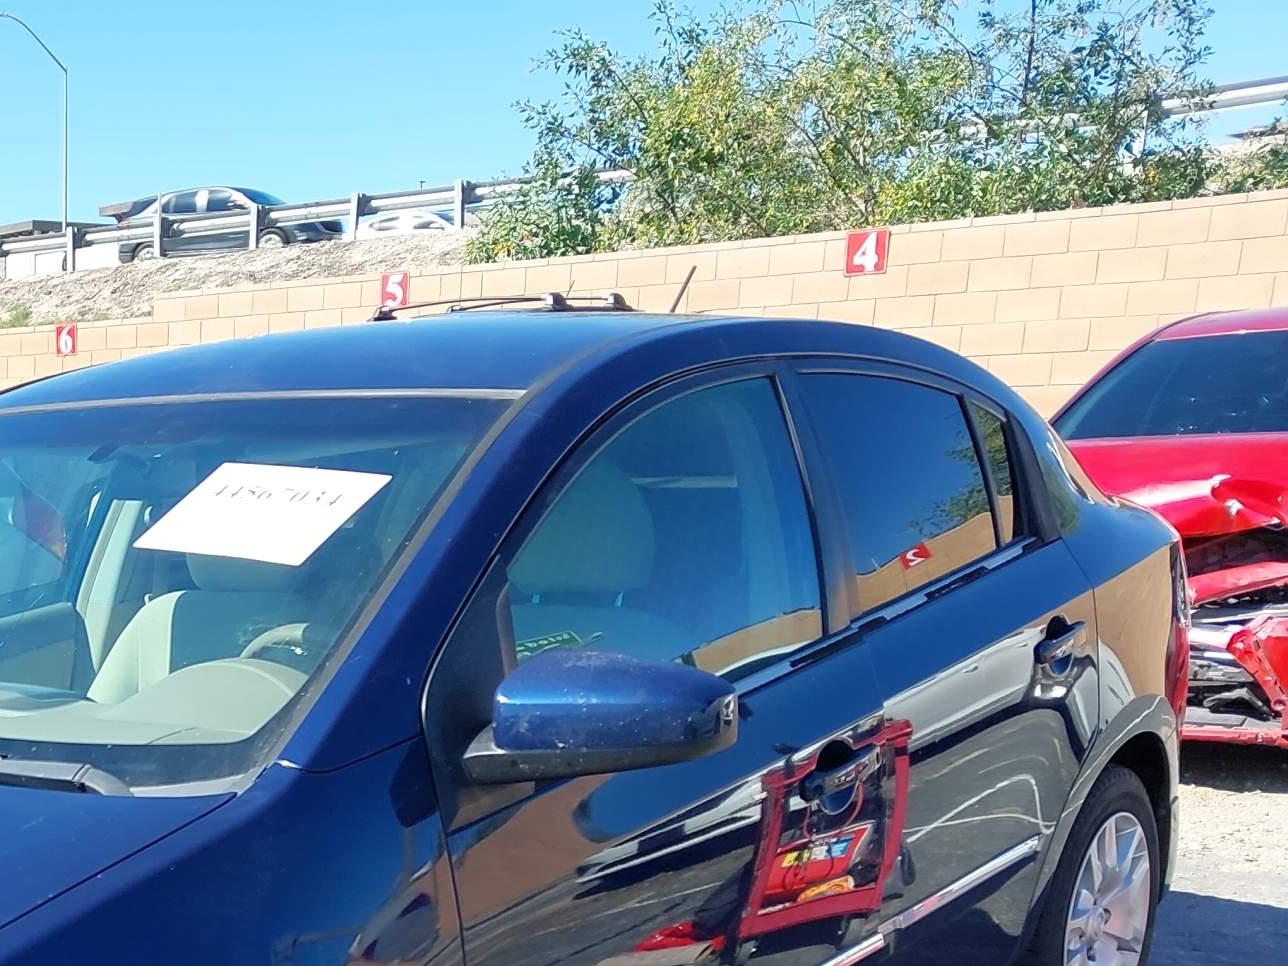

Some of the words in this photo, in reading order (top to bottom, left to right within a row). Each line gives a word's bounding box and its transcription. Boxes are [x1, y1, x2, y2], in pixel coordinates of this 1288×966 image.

[852, 231, 879, 272] 4
[384, 273, 404, 309] 5
[59, 325, 73, 354] 6
